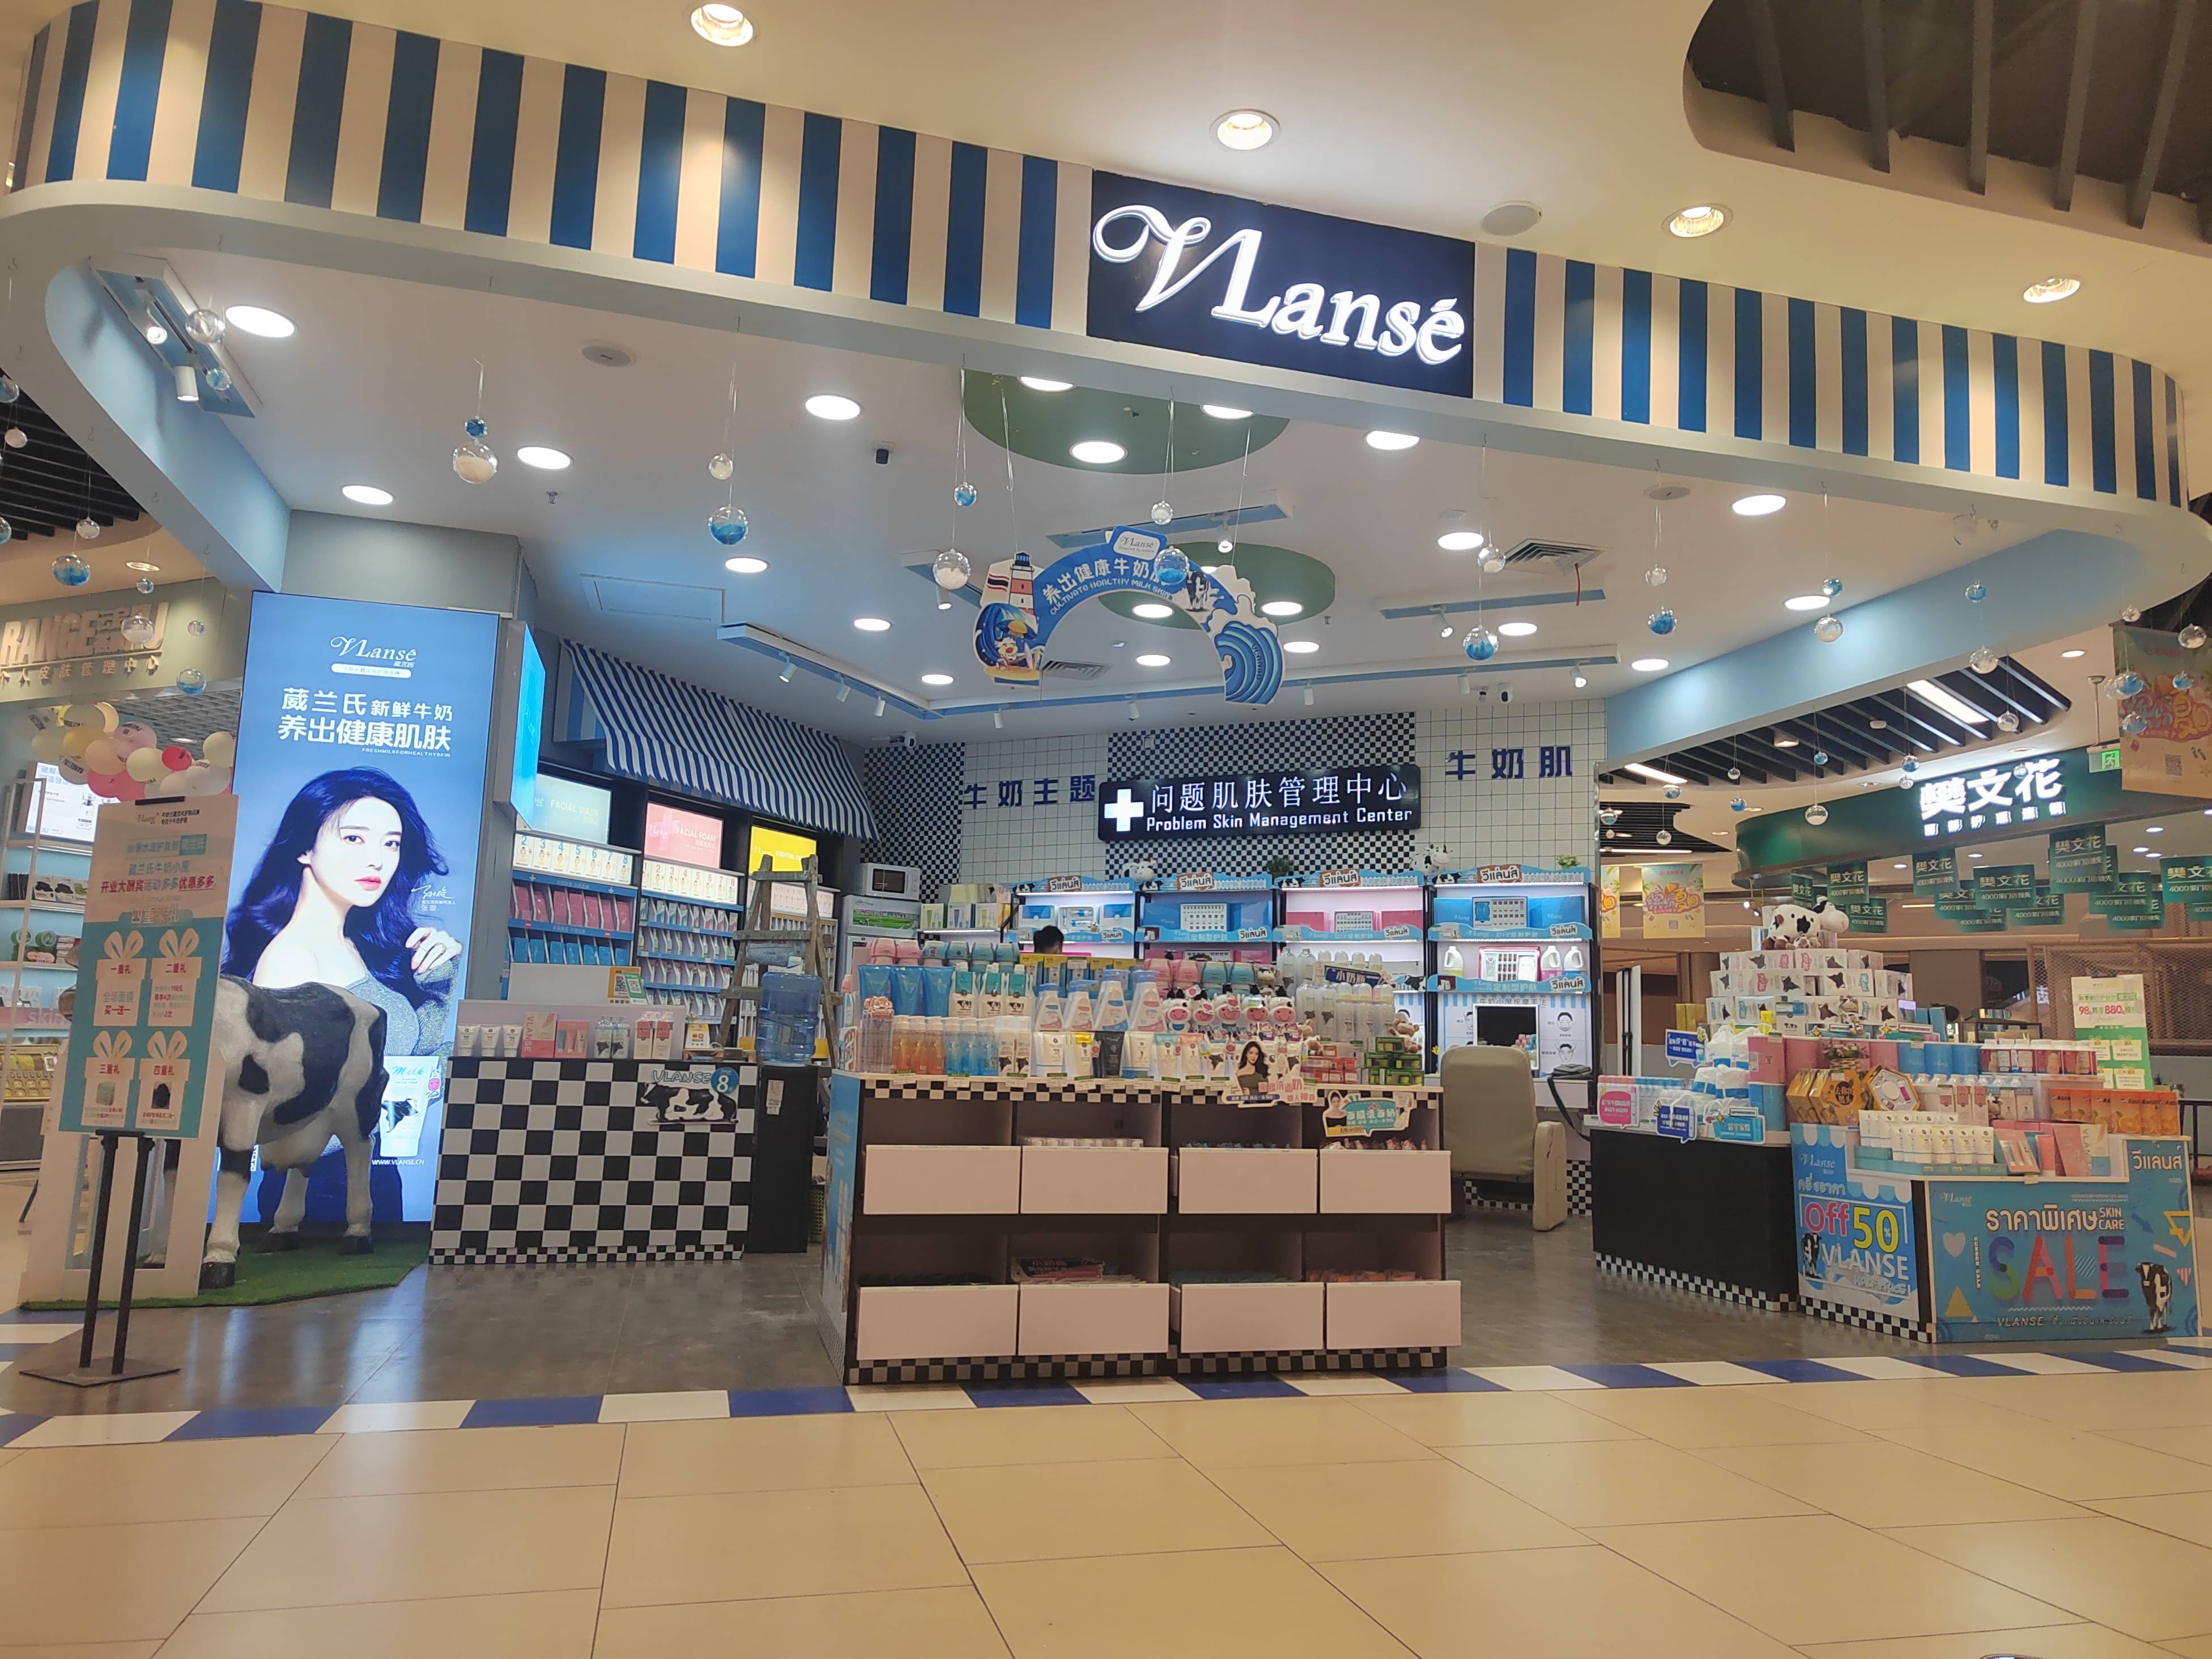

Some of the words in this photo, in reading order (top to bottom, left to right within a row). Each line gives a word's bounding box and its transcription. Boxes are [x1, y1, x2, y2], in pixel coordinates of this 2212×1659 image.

[278, 714, 452, 751] 养出健康肌肤
[1445, 745, 1572, 780] 牛奶肌
[964, 775, 1096, 809] 牛奶主题
[1151, 772, 1406, 814] 问题肌肤管理中心
[1920, 758, 2066, 820] 樊文花
[1147, 817, 1206, 831] Problem
[1213, 814, 1243, 828] Skin
[1249, 811, 1349, 828] Management
[1356, 807, 1412, 823] Center
[521, 835, 528, 845] 2
[540, 839, 546, 849] 3
[558, 842, 563, 853] 4
[576, 845, 581, 855] 5
[592, 849, 597, 858] 6
[607, 852, 612, 861] 7
[623, 854, 628, 864] 8
[2055, 835, 2102, 854] 樊文花
[656, 865, 661, 873] 2
[670, 867, 674, 875] 3
[683, 869, 687, 878] 4
[708, 874, 712, 882] 6
[718, 876, 723, 884] 7
[1979, 874, 2030, 888] 樊文花
[523, 1015, 534, 1053] VLANSE
[653, 1070, 712, 1084] VLANSE
[716, 1075, 729, 1092] 8
[1985, 1203, 2099, 1232] ราคาพิเศษ
[2098, 1219, 2126, 1230] CARE
[2099, 1207, 2122, 1218] SKIN
[1821, 1243, 1910, 1281] VLANSE
[1988, 1236, 2130, 1301] SALE
[1997, 1316, 2045, 1327] VLANSE
